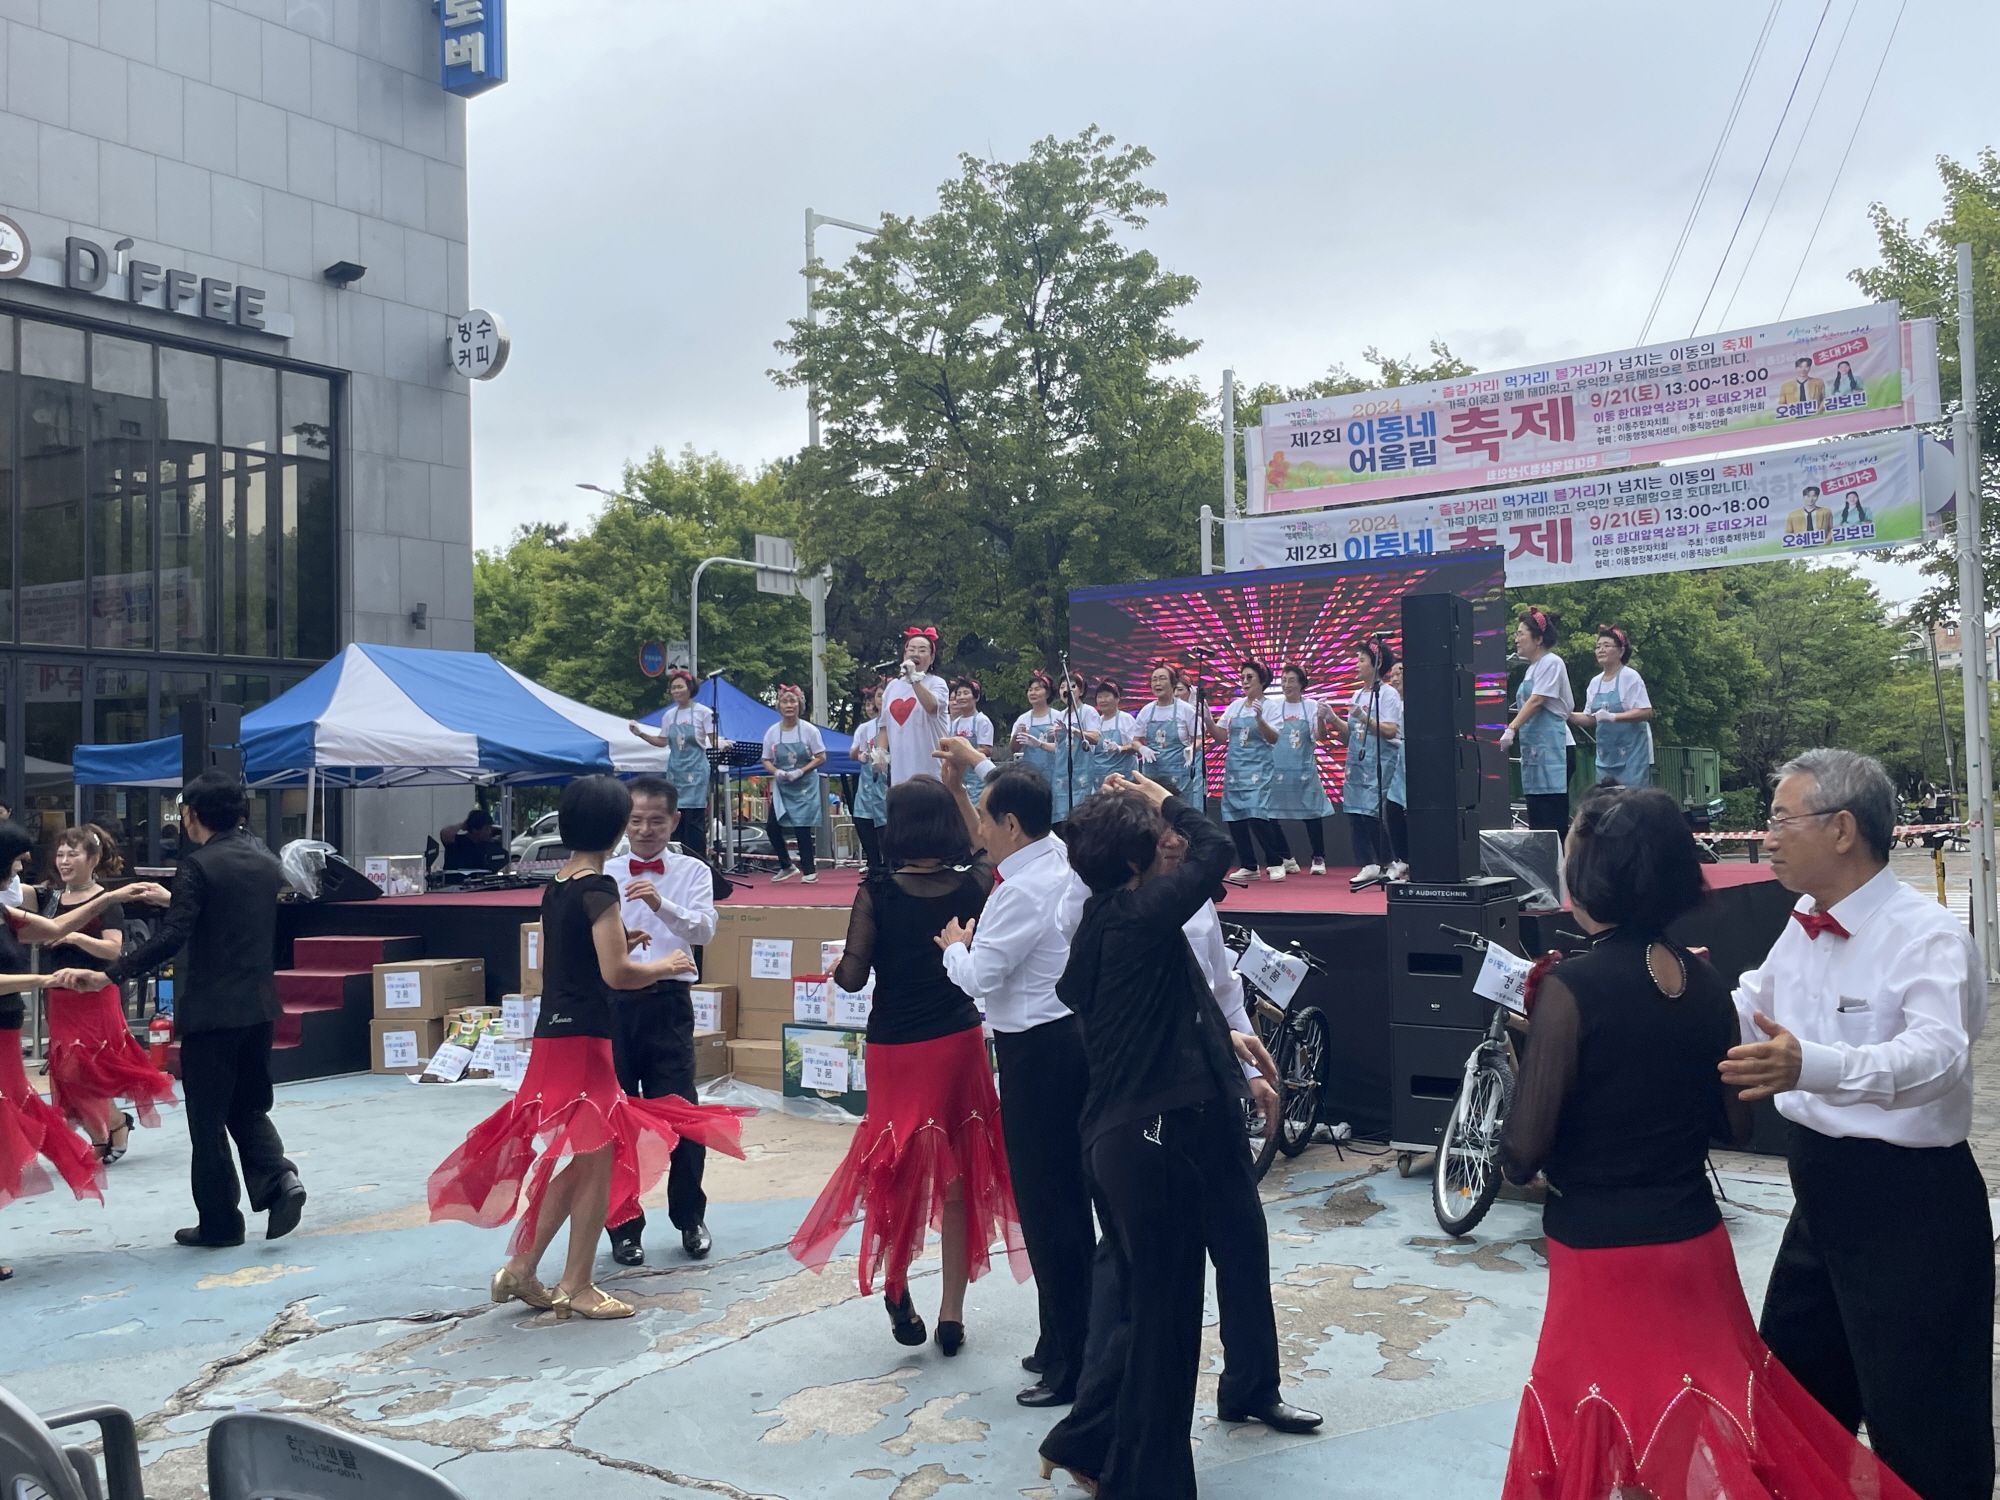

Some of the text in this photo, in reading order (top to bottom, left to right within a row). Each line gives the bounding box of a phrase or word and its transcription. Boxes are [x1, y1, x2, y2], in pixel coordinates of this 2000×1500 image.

[458, 319, 491, 343] 빙수
[458, 345, 489, 368] 커피
[1817, 339, 1864, 362] 초대가수
[1442, 335, 1753, 399] 즐길거리! 먹거리! 볼거리가 넘치는 이동의 축제
[1590, 367, 1769, 408] 9/21(토) 13:00~18:00
[1352, 398, 1402, 419] 2024
[1593, 410, 1616, 423] 이동
[1705, 386, 1767, 407] 로데오거리
[1776, 392, 1867, 420] 오혜빈 김보민
[1290, 427, 1341, 448] 제2회
[1347, 410, 1437, 446] 이동네
[1441, 395, 1576, 463] 축제
[1349, 439, 1437, 474] 어울림
[1439, 462, 1753, 517] 즐길거리! 먹거리! 볼거리가 넘치는 이동의 축제
[1825, 470, 1873, 493] 초대가수
[1348, 514, 1399, 534] 2024
[1589, 496, 1770, 530] 9/21(토) 13:00~18:00
[1344, 528, 1434, 561] 이동네
[1592, 534, 1614, 546] 이동
[1705, 515, 1768, 534] 로데오거리
[1782, 524, 1875, 548] 오혜빈 김보민
[1285, 542, 1337, 562] 제2회
[1415, 889, 1468, 897] AUDIOTECHNIK
